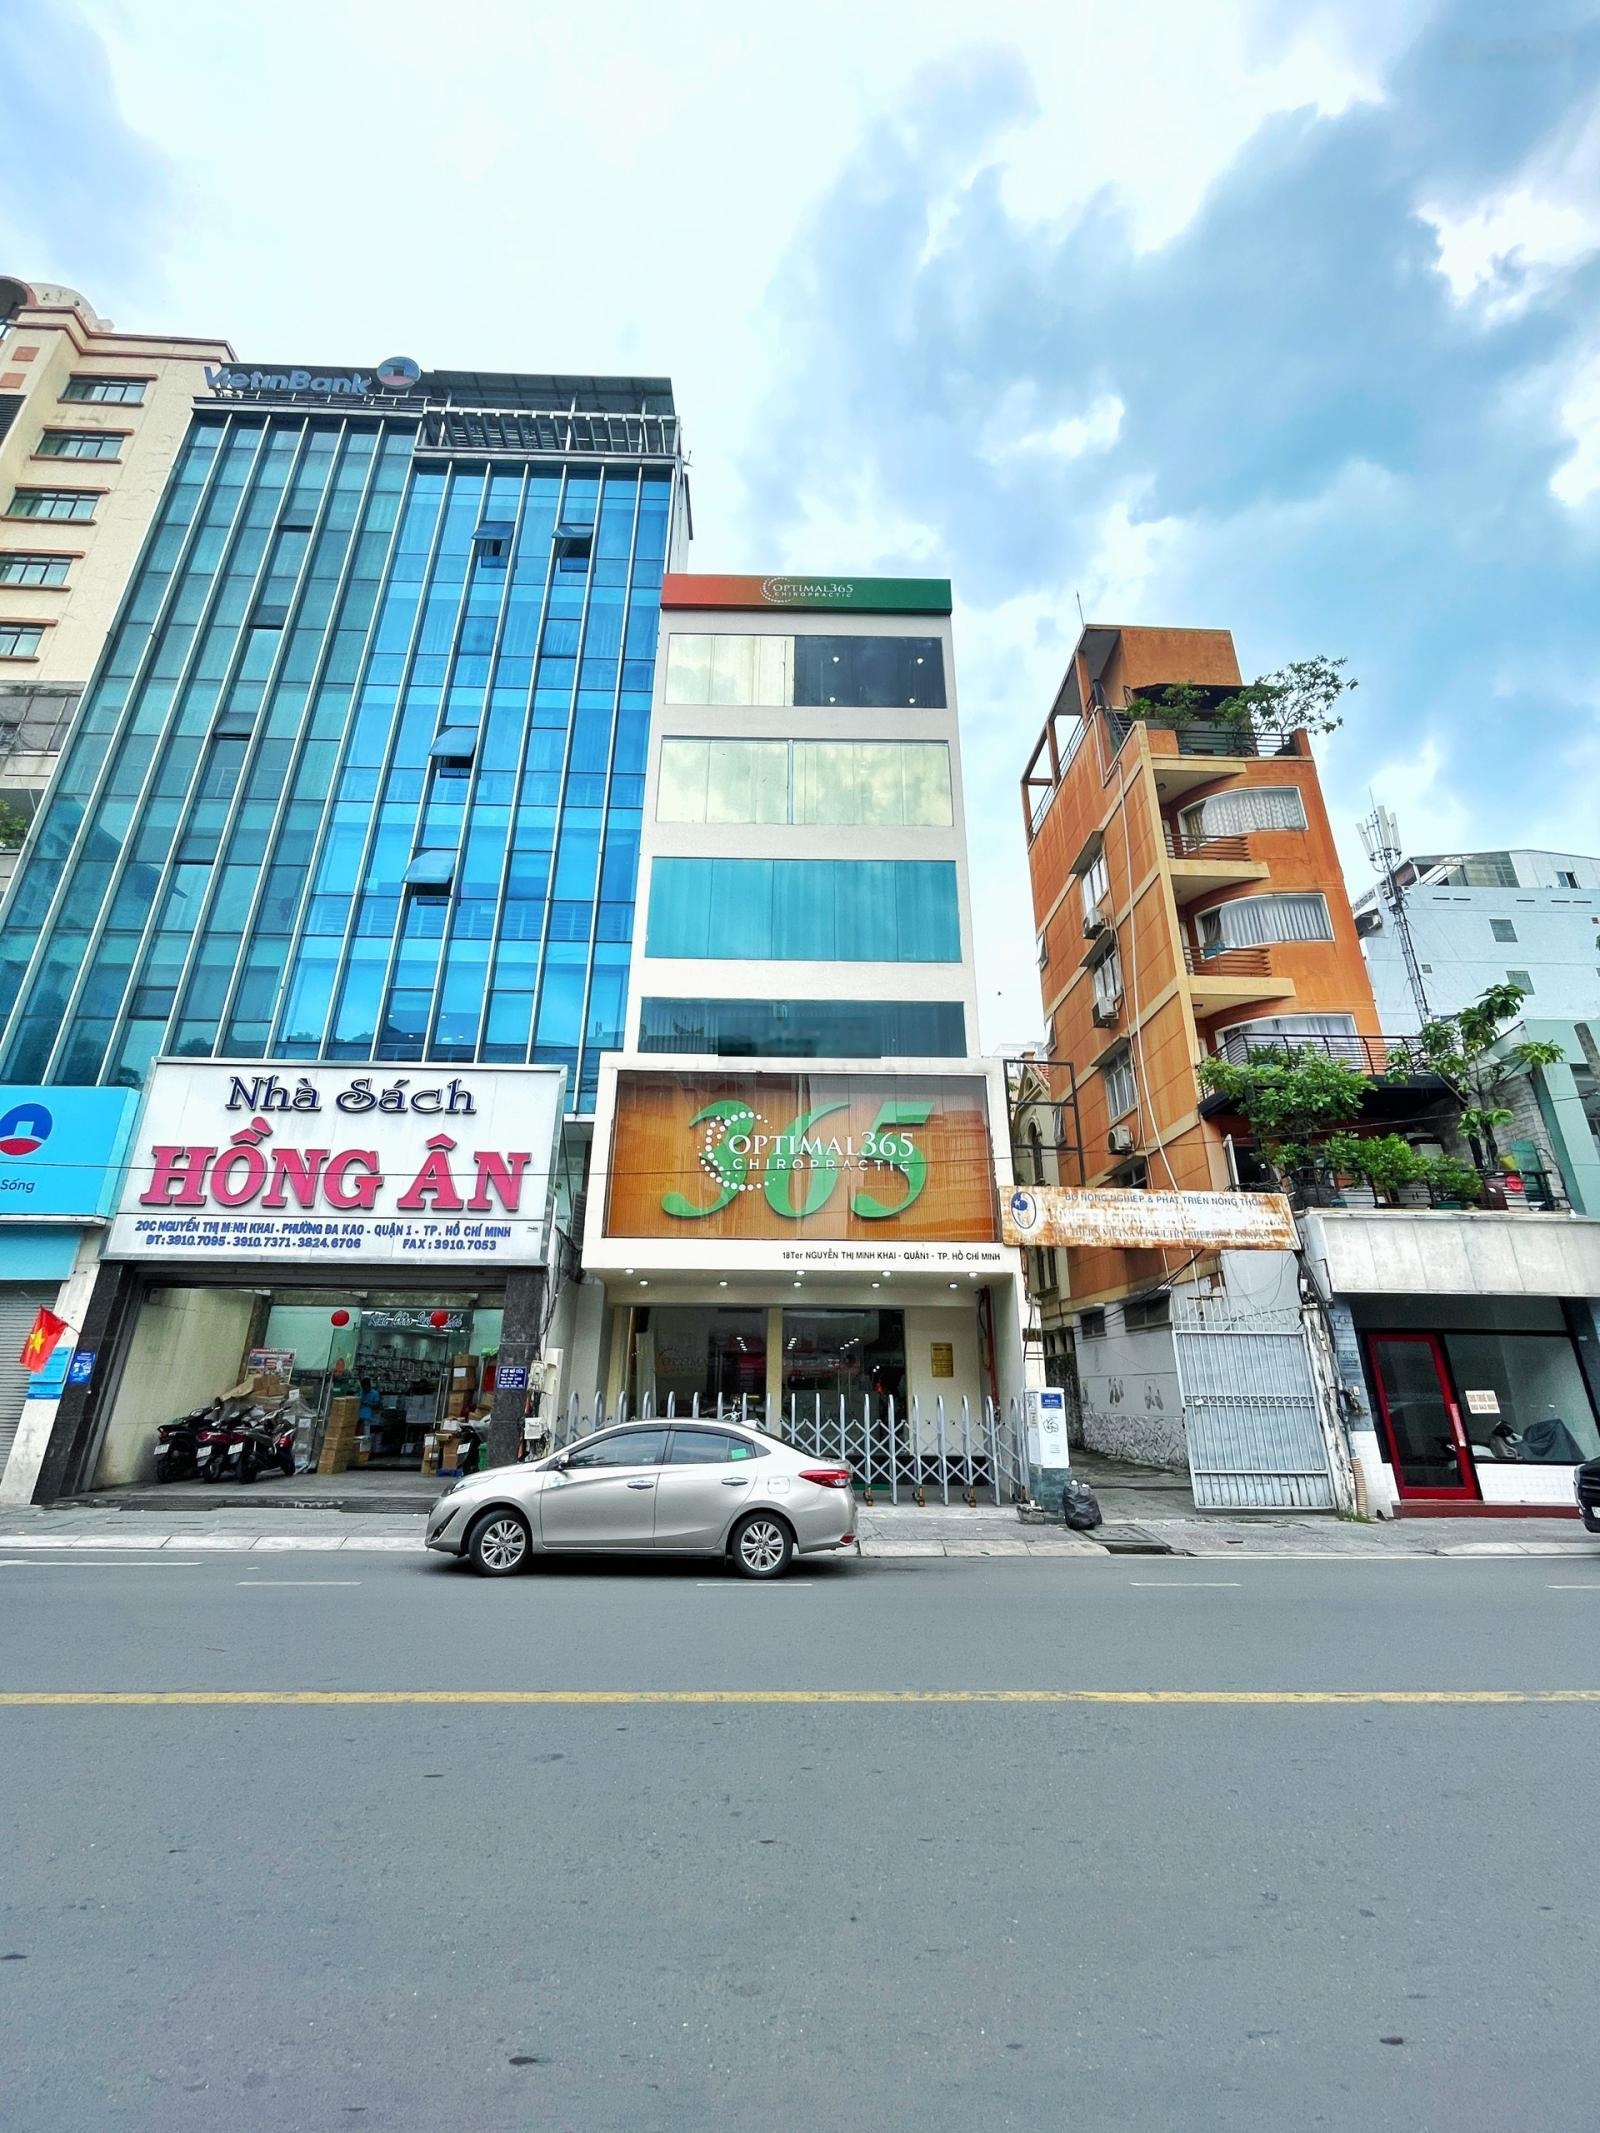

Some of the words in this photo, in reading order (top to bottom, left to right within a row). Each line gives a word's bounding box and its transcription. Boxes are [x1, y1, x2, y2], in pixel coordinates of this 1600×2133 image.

[773, 584, 854, 593] OPTIMAL365
[225, 1075, 322, 1113] Nhà
[336, 1078, 477, 1115] Sách
[728, 1132, 914, 1158] OPTIMAL365
[139, 1116, 385, 1209] HỒNG
[396, 1133, 532, 1212] ÂN
[661, 1099, 936, 1218] 365
[733, 1157, 910, 1172] CHIROPRACTIC
[0, 1178, 35, 1193] Sống
[135, 1220, 157, 1232] 20C
[202, 1221, 220, 1235] THỊ
[249, 1222, 275, 1234] KHAI
[282, 1220, 323, 1234] PHƯỜNG
[342, 1224, 364, 1235] KAO
[374, 1222, 403, 1238] QUẬN
[406, 1225, 412, 1235] 1
[464, 1223, 483, 1237] CHÍ
[485, 1226, 511, 1238] MINH
[782, 1251, 803, 1259] 18Ter
[841, 1251, 854, 1260] THỊ
[856, 1251, 875, 1259] MINH
[877, 1251, 896, 1259] KHAI
[966, 1251, 979, 1260] CHÍ
[982, 1252, 1000, 1260] MINH
